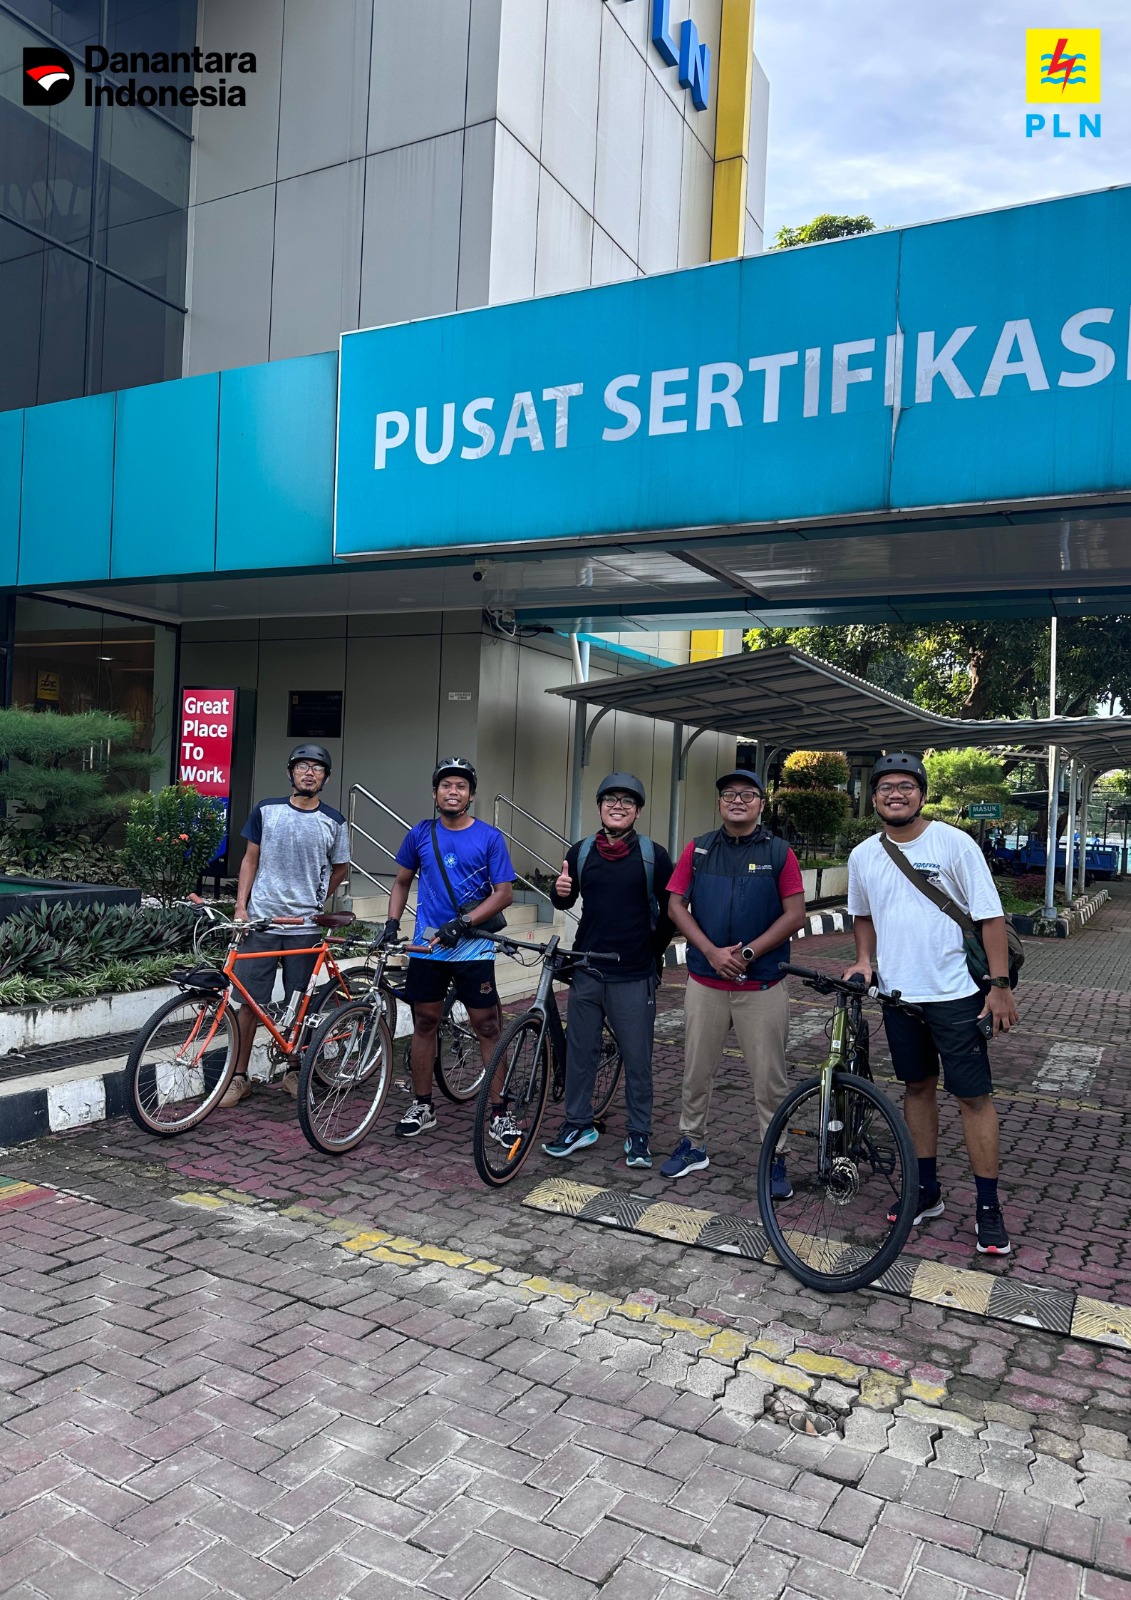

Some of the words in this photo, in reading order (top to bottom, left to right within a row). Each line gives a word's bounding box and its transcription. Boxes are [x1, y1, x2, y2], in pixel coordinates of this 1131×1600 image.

[650, 0, 711, 112] LN
[374, 382, 584, 470] PUSAT
[184, 696, 230, 715] Great
[183, 719, 228, 738] Place
[182, 742, 204, 761] To
